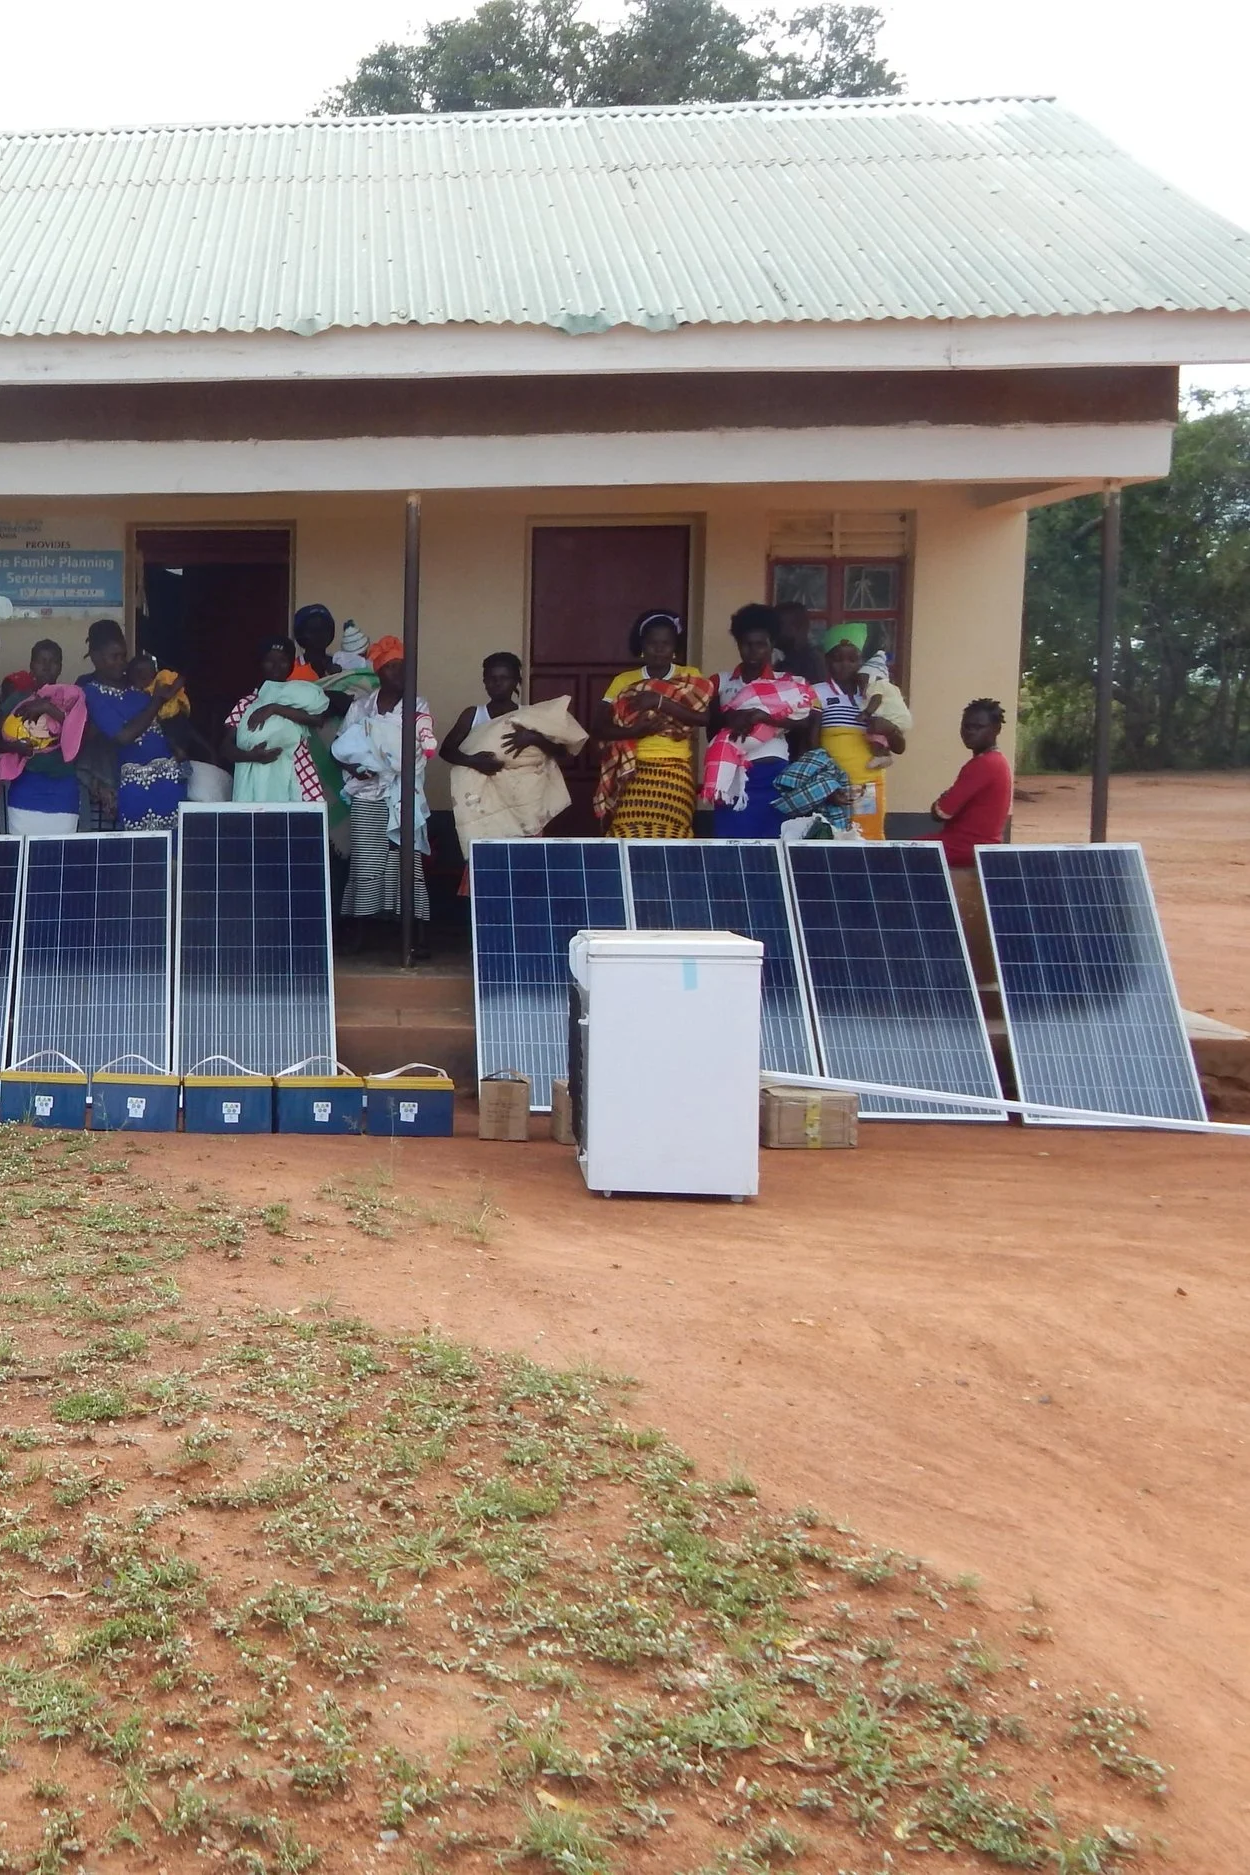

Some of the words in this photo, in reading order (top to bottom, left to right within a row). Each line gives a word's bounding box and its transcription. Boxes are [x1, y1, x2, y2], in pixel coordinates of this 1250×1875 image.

[25, 540, 71, 549] PROVIDES
[13, 555, 55, 569] Family
[59, 556, 115, 571] Planning
[6, 572, 58, 584] Services
[61, 572, 92, 584] Here
